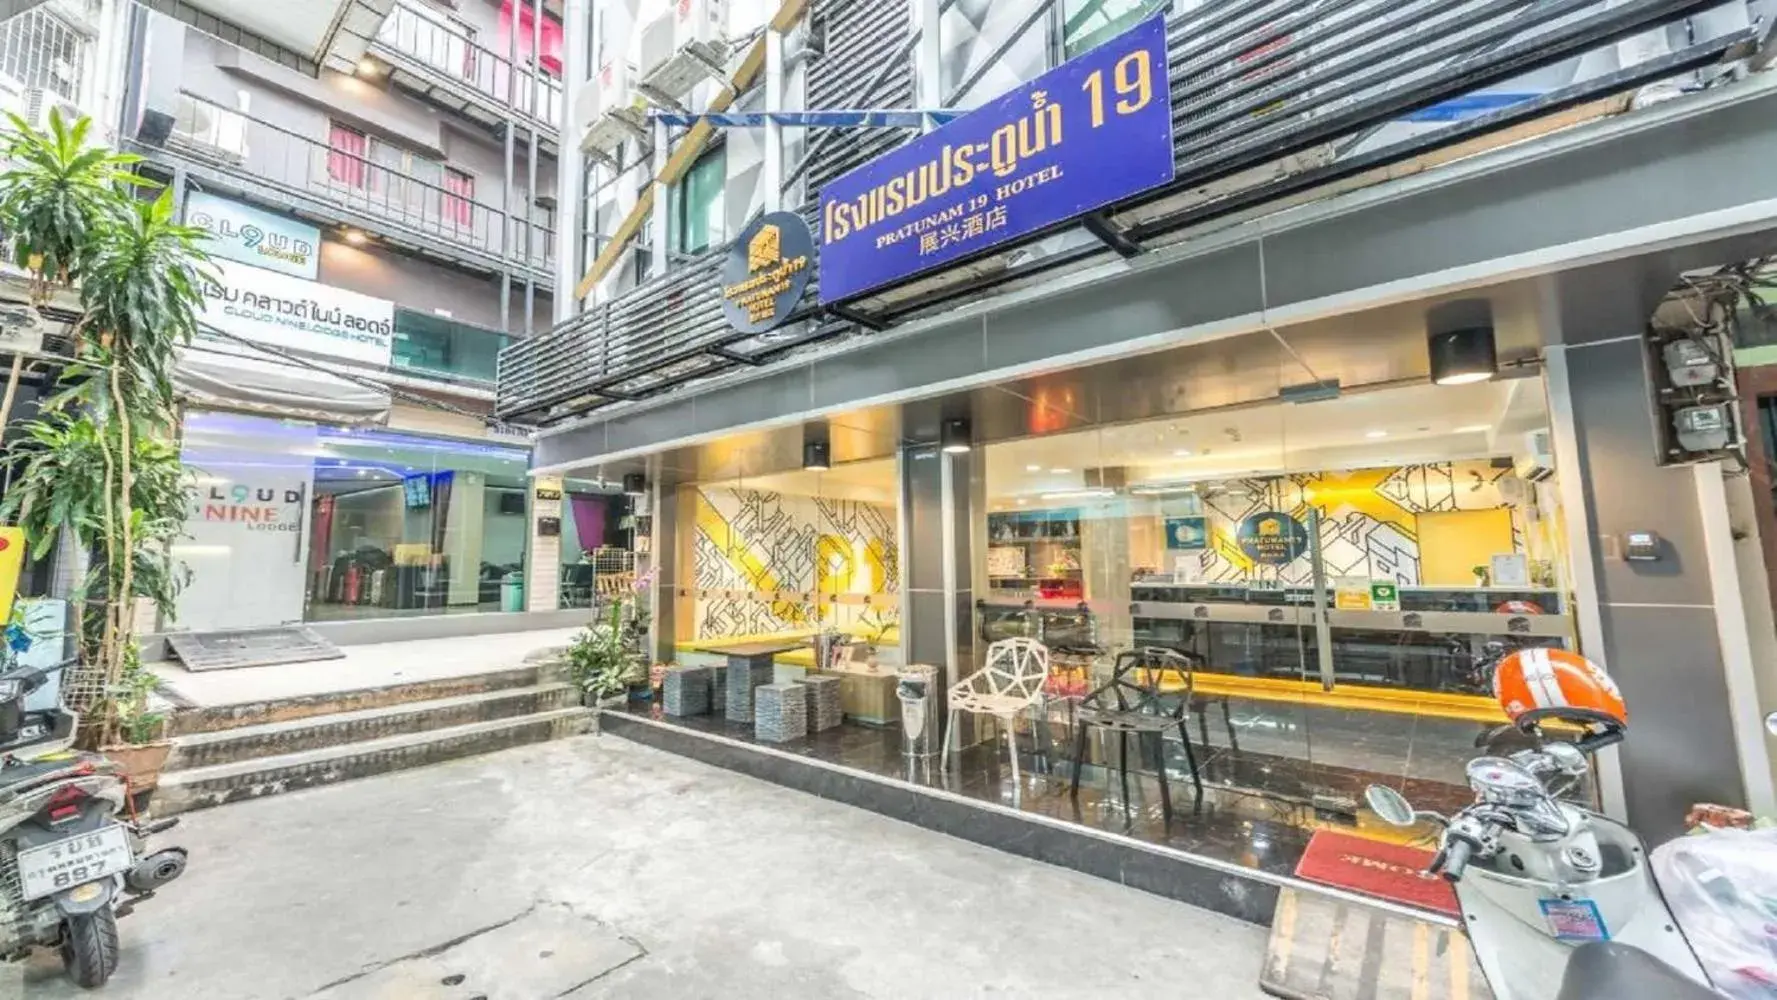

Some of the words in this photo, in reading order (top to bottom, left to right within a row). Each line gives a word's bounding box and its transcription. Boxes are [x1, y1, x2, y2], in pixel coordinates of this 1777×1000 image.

[1082, 50, 1152, 128] 19
[876, 203, 964, 249] PRATUNAM
[968, 193, 989, 213] 19
[996, 164, 1064, 201] HOTEL
[919, 205, 1008, 256] 展兴酒店
[223, 305, 274, 323] CLOUD
[275, 316, 305, 331] NINE
[350, 334, 389, 348] HOTEL
[206, 504, 278, 522] NINE
[247, 521, 302, 532] LODGE
